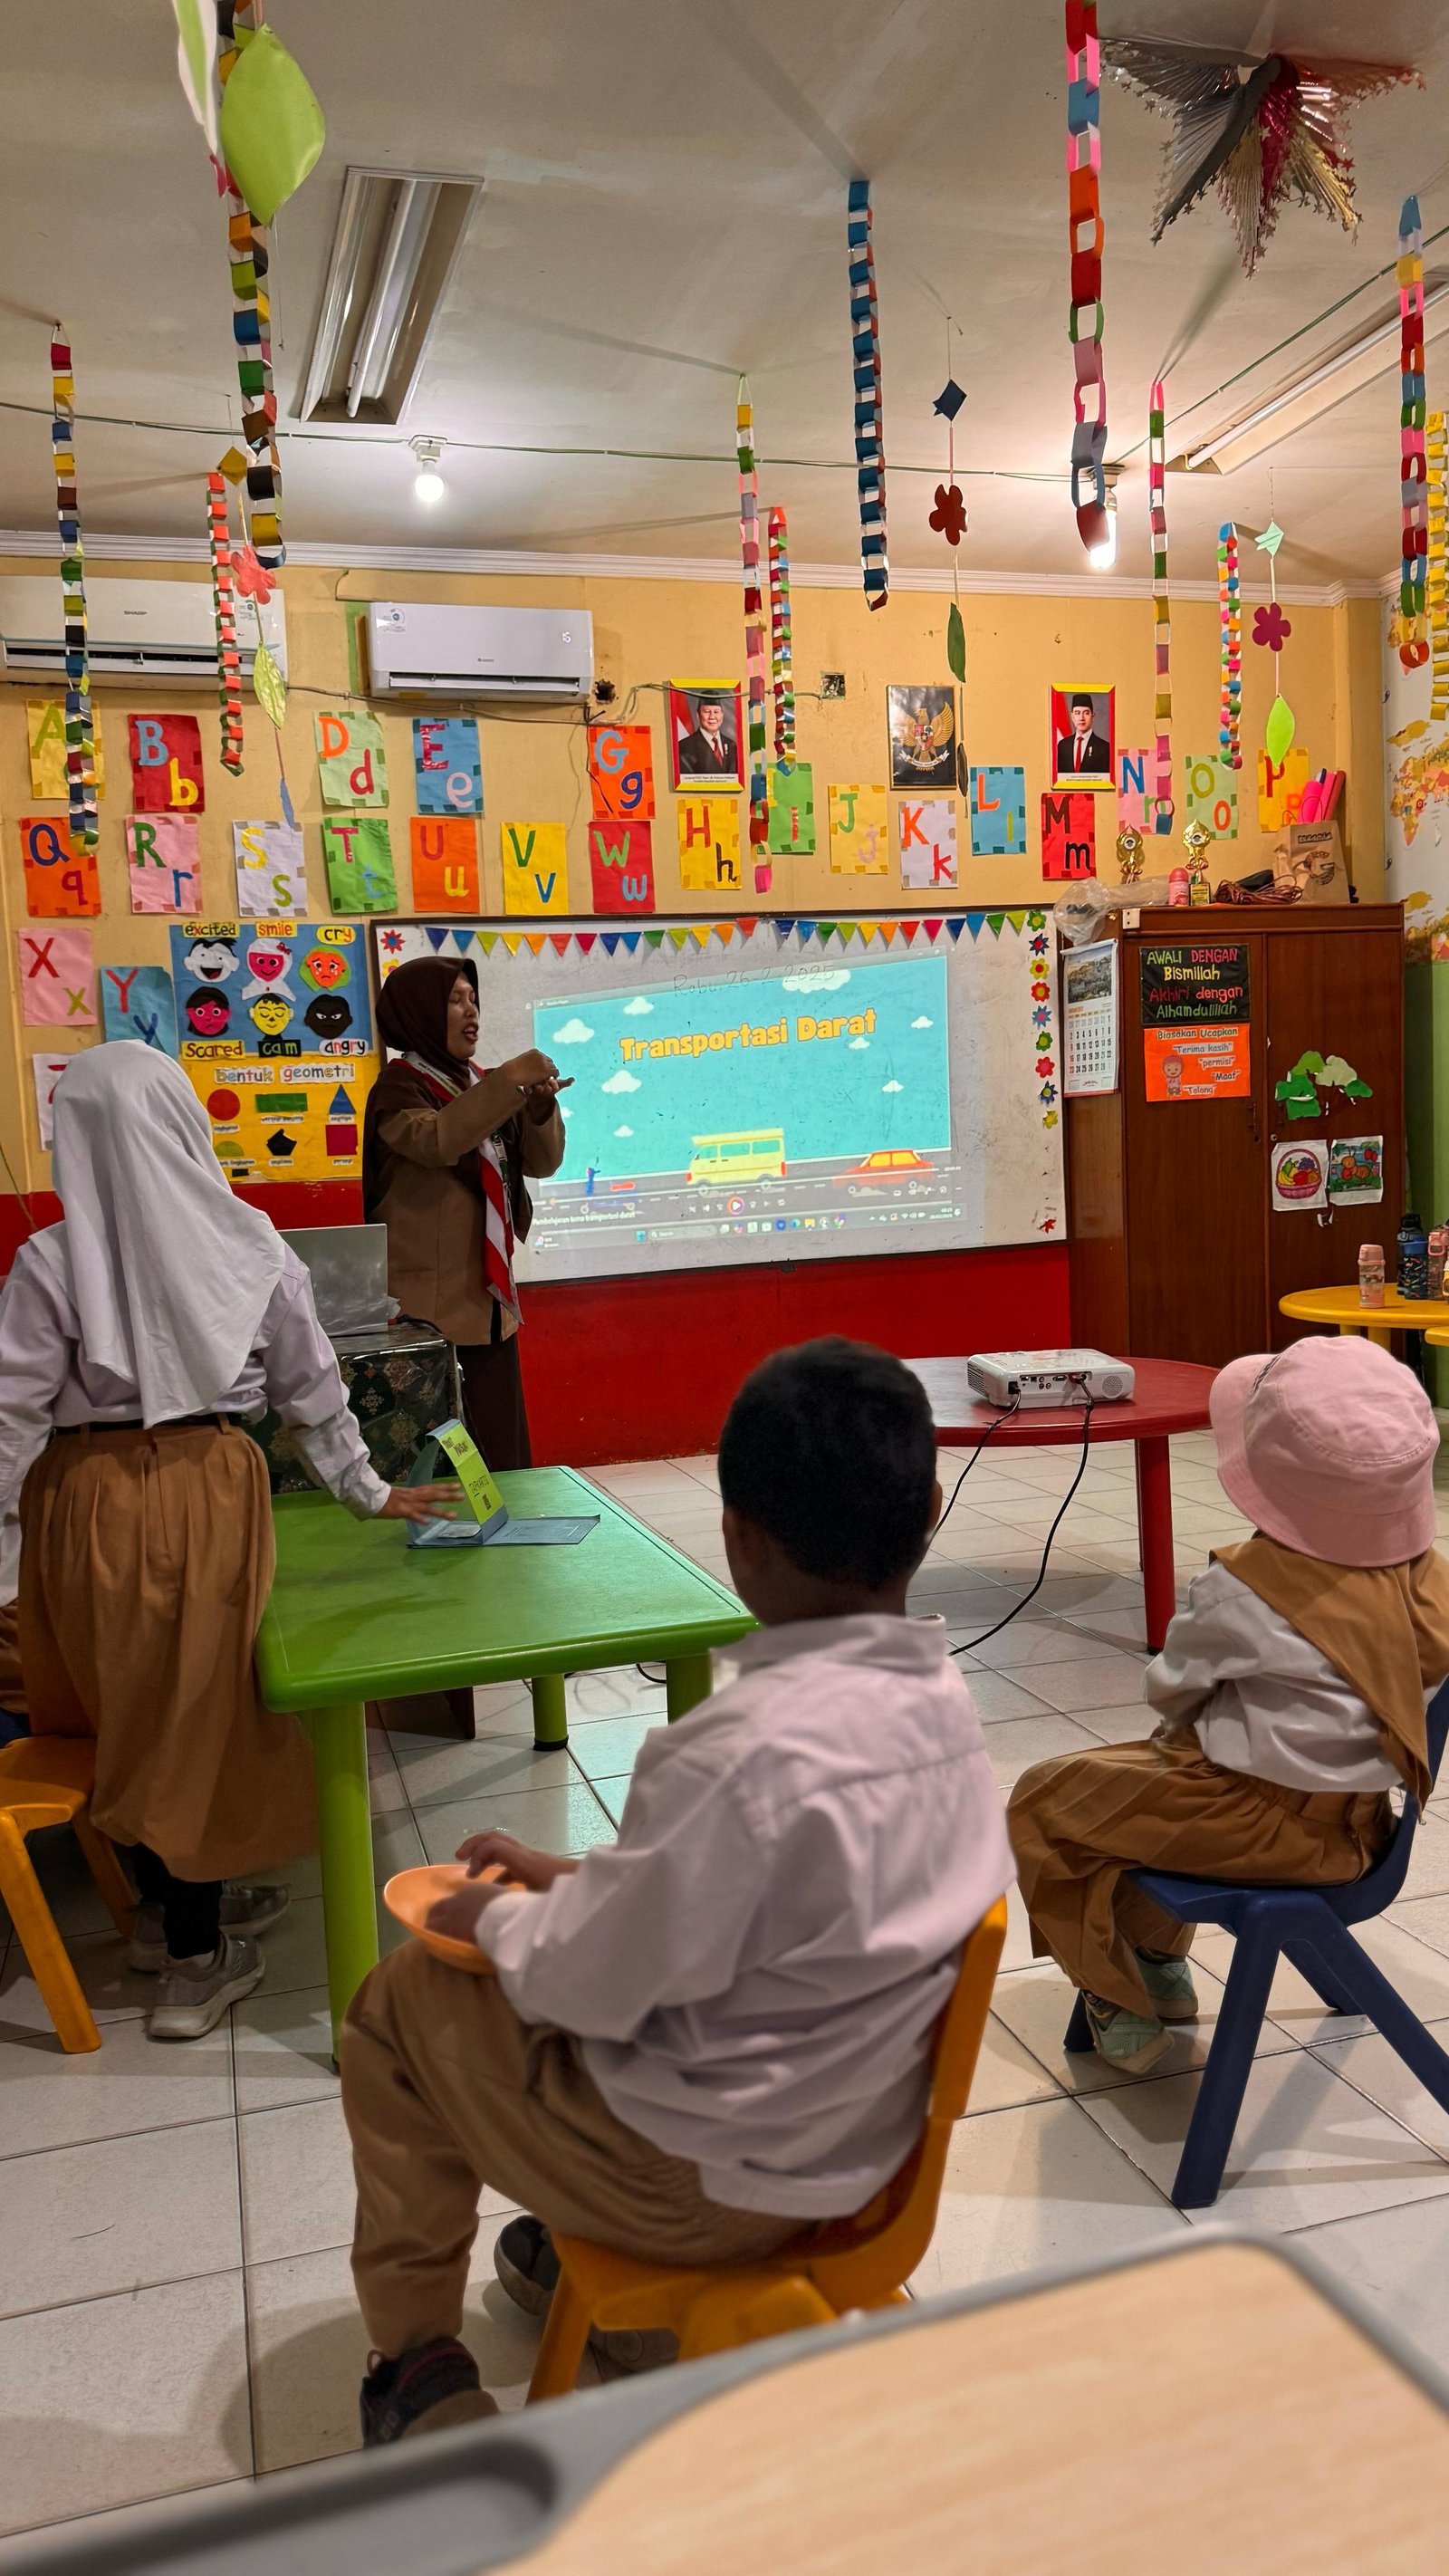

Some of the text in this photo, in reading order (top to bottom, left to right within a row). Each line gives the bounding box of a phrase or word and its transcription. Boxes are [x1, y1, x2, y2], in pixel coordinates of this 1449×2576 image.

[135, 720, 169, 766] B
[317, 716, 350, 758] D
[419, 724, 449, 771] E
[595, 730, 629, 774] G
[169, 758, 198, 806] b
[350, 749, 374, 794] d
[1122, 756, 1145, 794] N
[1190, 762, 1215, 798] O
[1264, 755, 1285, 798] P
[446, 772, 474, 809] e
[619, 771, 642, 810] g
[976, 773, 1000, 812] L
[686, 805, 711, 848] H
[838, 793, 859, 833] J
[901, 806, 930, 848] K
[1045, 796, 1070, 834] M
[1214, 800, 1231, 831] o
[29, 823, 70, 866] Q
[132, 822, 167, 868] R
[241, 826, 269, 869] S
[331, 827, 359, 863] T
[420, 825, 444, 860] U
[508, 828, 536, 867] V
[592, 831, 630, 868] W
[858, 824, 879, 863] j
[1064, 840, 1092, 870] m
[715, 841, 737, 883] h
[933, 843, 953, 881] k
[61, 870, 89, 906] q
[172, 870, 193, 908] r
[273, 874, 291, 907] s
[361, 865, 384, 899] t
[444, 866, 469, 898] u
[534, 872, 556, 903] v
[621, 874, 648, 901] w
[185, 922, 236, 936] excited
[259, 923, 292, 936] smile
[323, 928, 353, 943] cry
[24, 937, 61, 978] X
[1147, 948, 1238, 965] AWALI DENGAN
[1163, 964, 1221, 981] Bismillah
[63, 987, 91, 1016] x
[105, 966, 139, 1014] Y
[1148, 985, 1243, 1004] Akhiri dengan
[133, 1013, 158, 1044] y
[324, 1039, 366, 1054] angry
[619, 1006, 877, 1062] Transportasi Darat
[1088, 1041, 1093, 1049] 12
[1157, 1027, 1238, 1040] Biasakan Ucapkan
[186, 1041, 243, 1058] Scared
[216, 1062, 355, 1083] bentuk geometri
